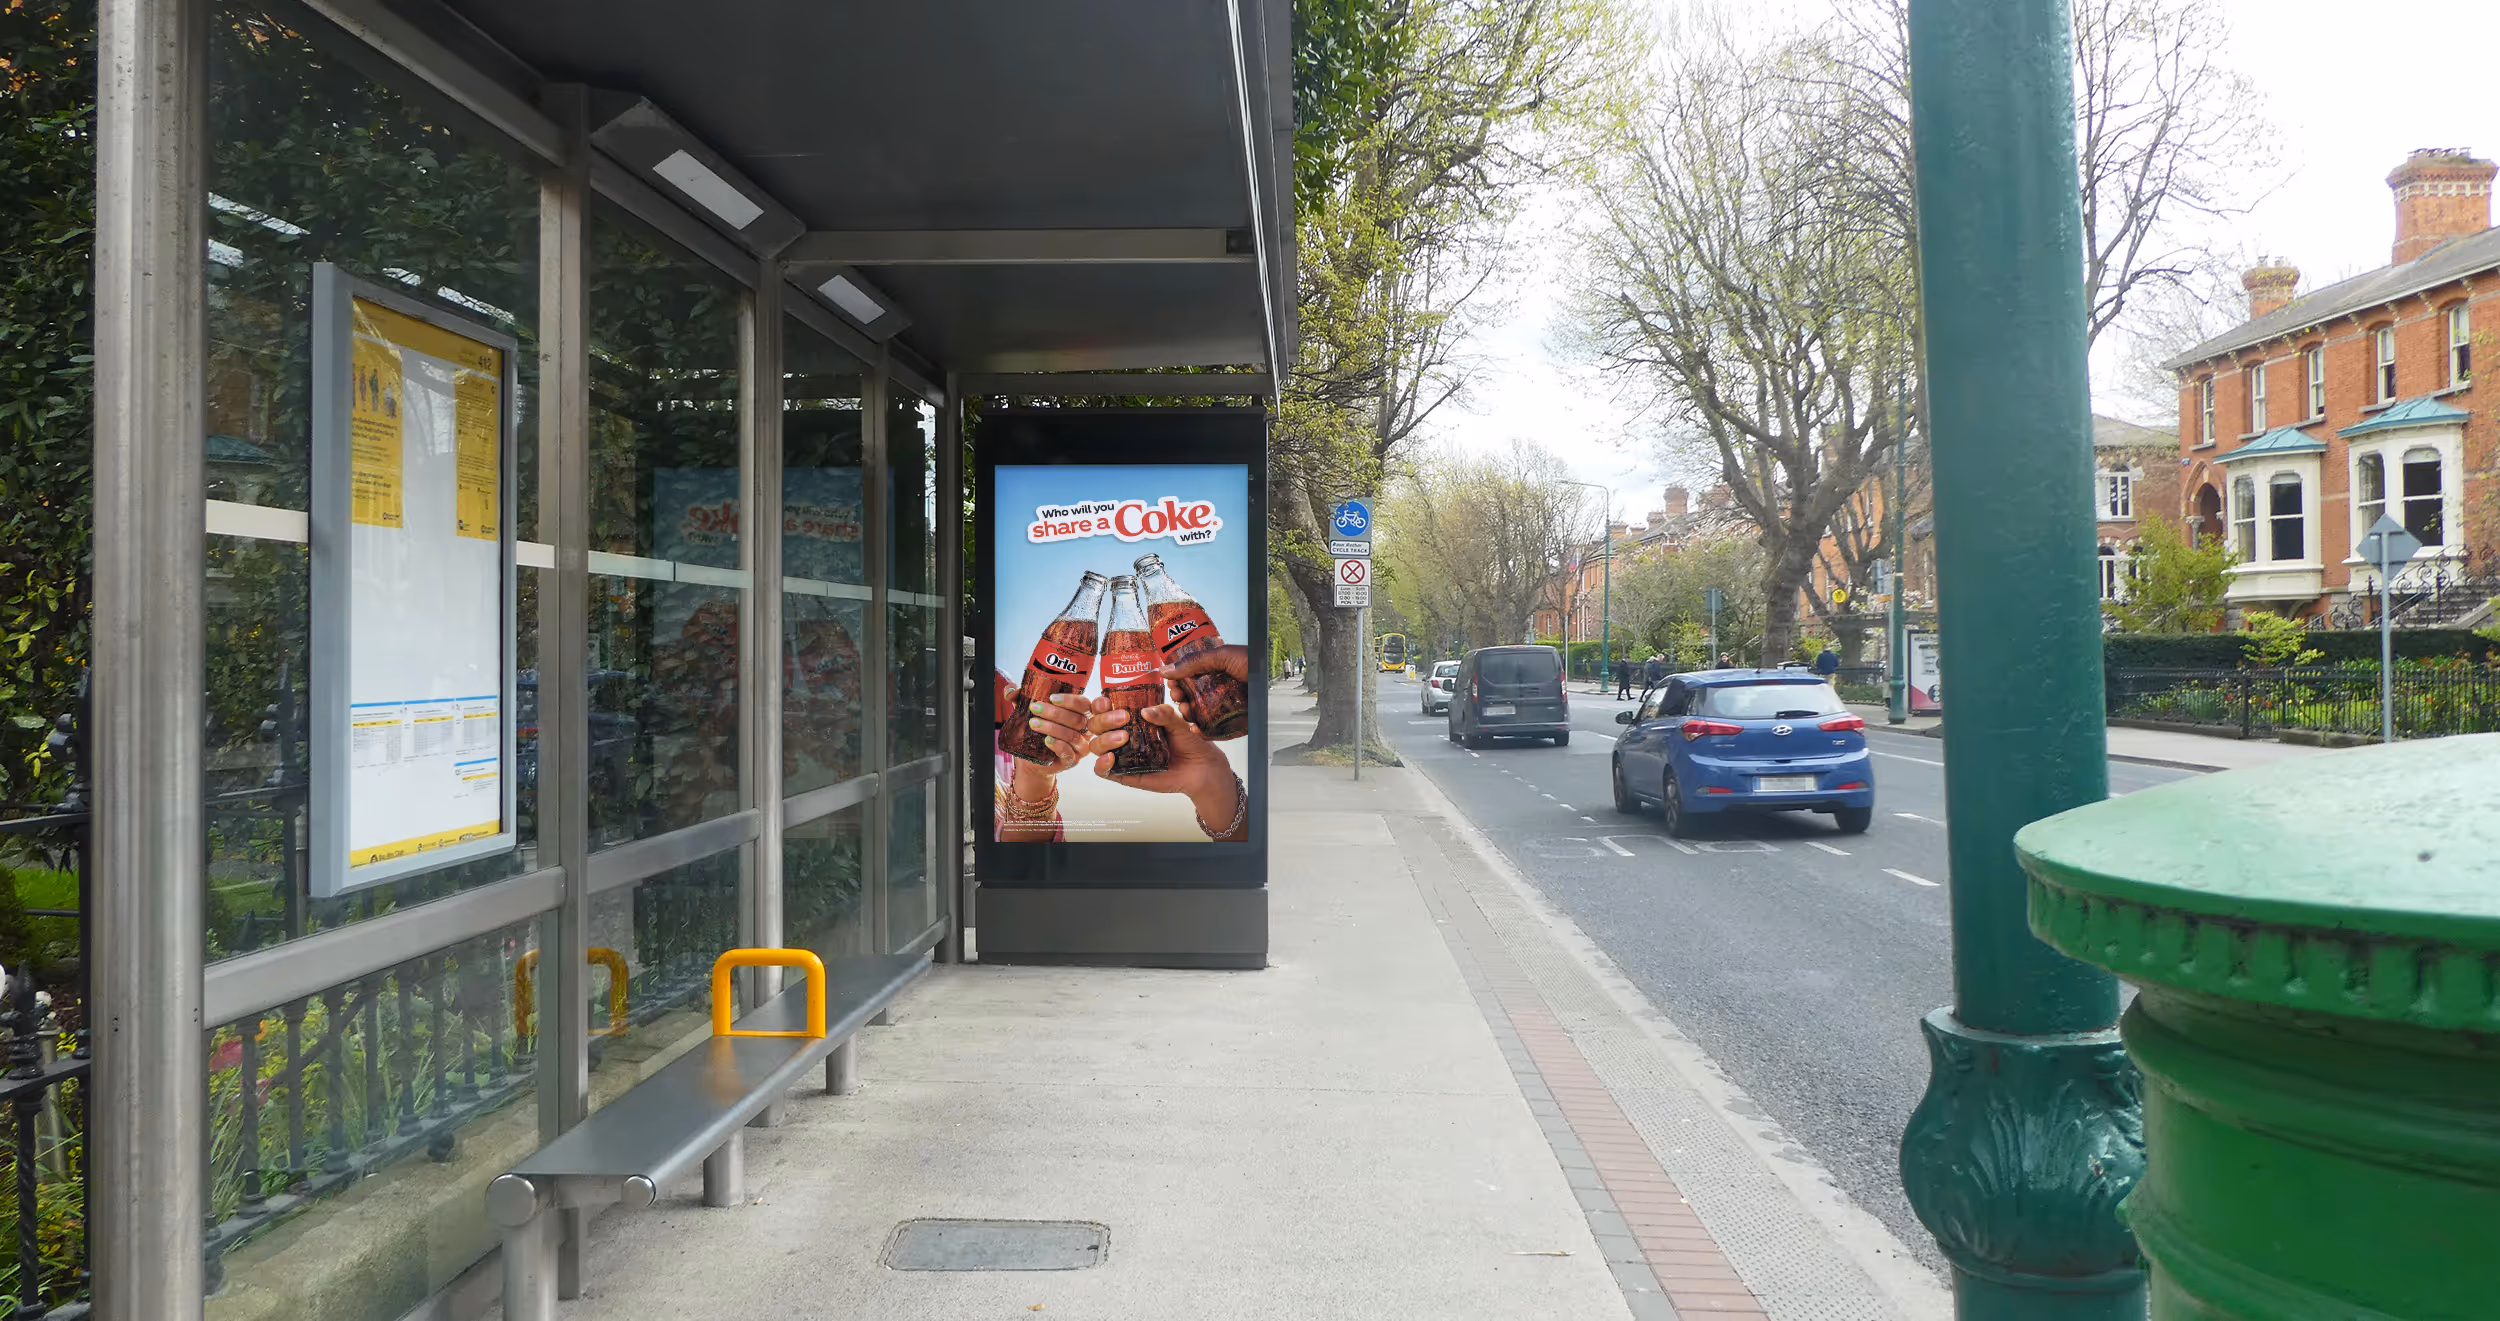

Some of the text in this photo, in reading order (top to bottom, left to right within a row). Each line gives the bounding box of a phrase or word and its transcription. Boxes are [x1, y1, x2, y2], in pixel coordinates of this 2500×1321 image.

[1042, 502, 1115, 518] Who will you
[1032, 518, 1093, 538] share
[1096, 517, 1111, 530] a
[1180, 530, 1212, 542] with?
[1168, 620, 1199, 640] Alex
[1046, 653, 1078, 673] Orla
[1112, 661, 1152, 675] Daniel
